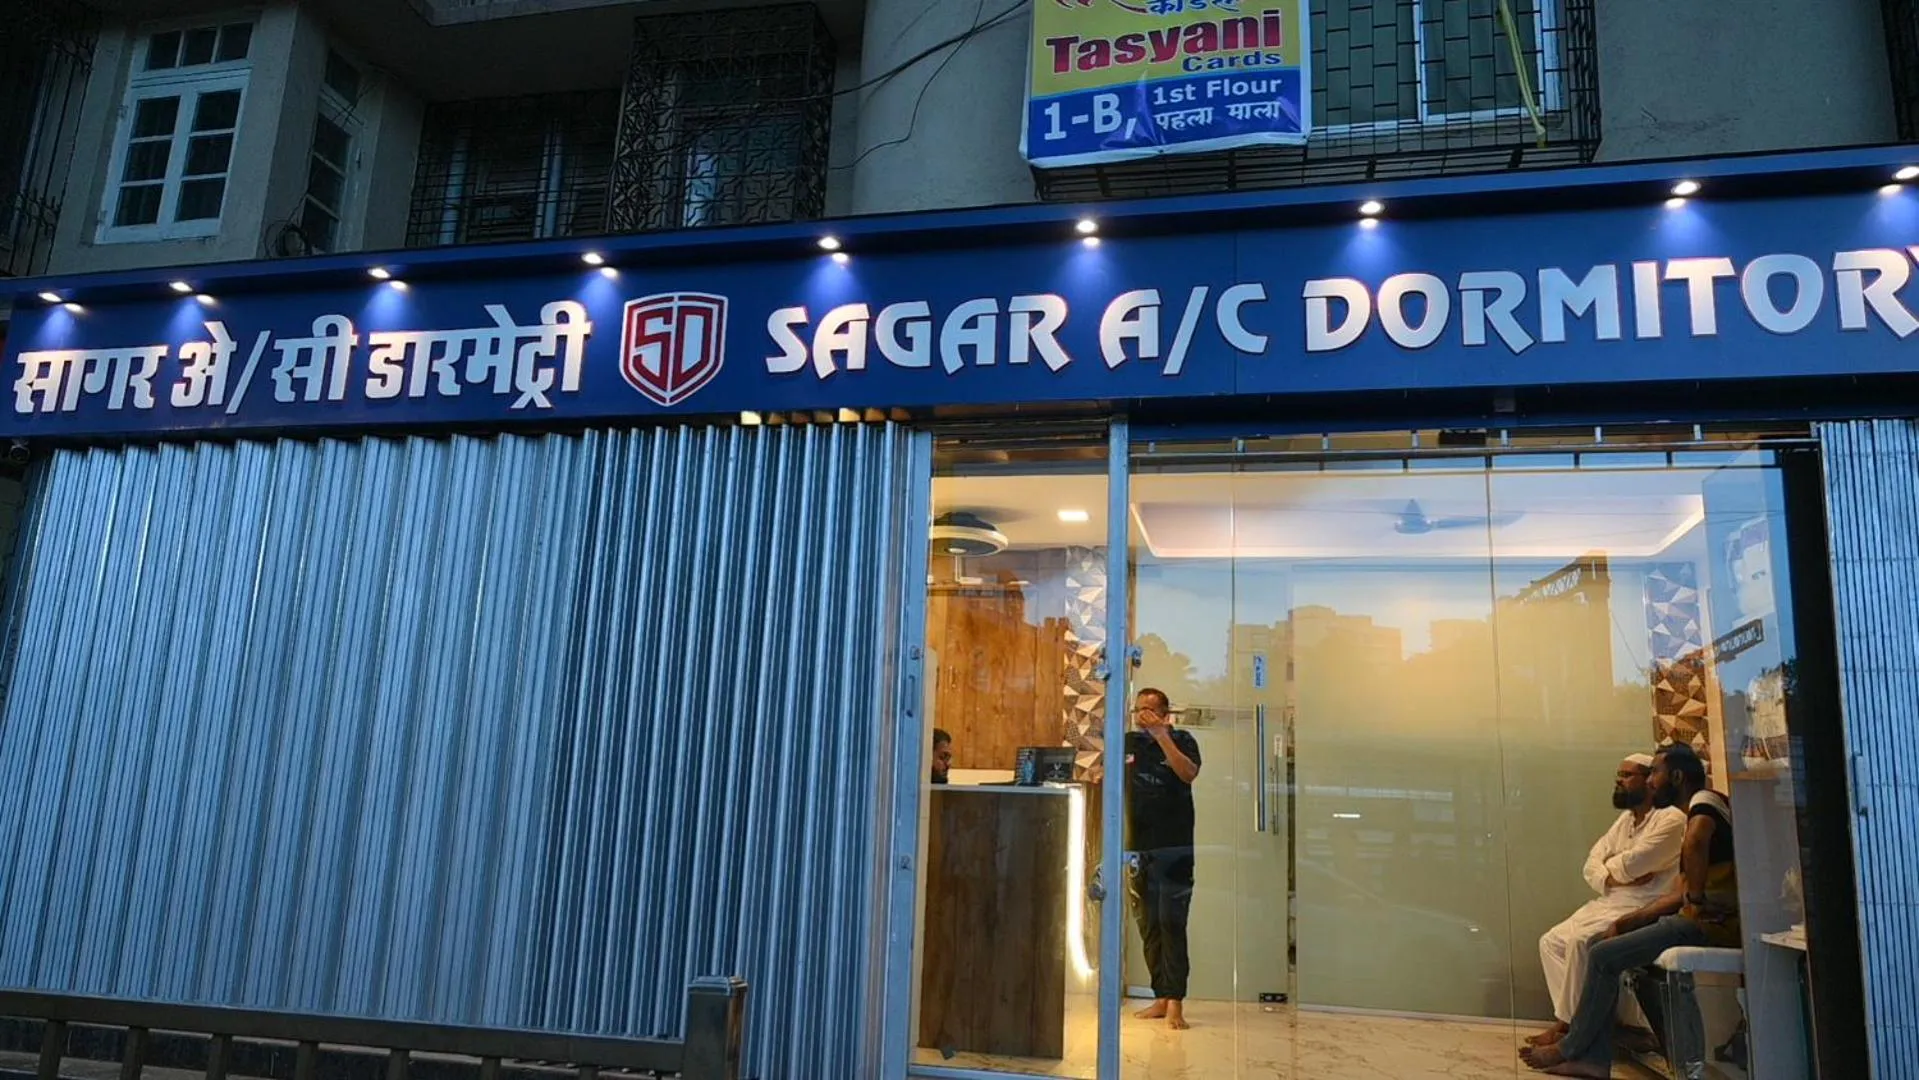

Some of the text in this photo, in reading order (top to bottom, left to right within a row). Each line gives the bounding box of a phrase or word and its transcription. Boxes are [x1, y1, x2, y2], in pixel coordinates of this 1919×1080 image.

[1046, 9, 1281, 73] Tasyani
[1182, 51, 1281, 72] Cards
[1153, 78, 1282, 105] 1st Flour
[1044, 93, 1137, 140] 1-B,
[1153, 101, 1281, 130] पहला माला
[766, 294, 1069, 379] SAGAR
[1099, 283, 1267, 375] A/C
[14, 346, 168, 413] सागर
[365, 301, 592, 409] डारमेट्री
